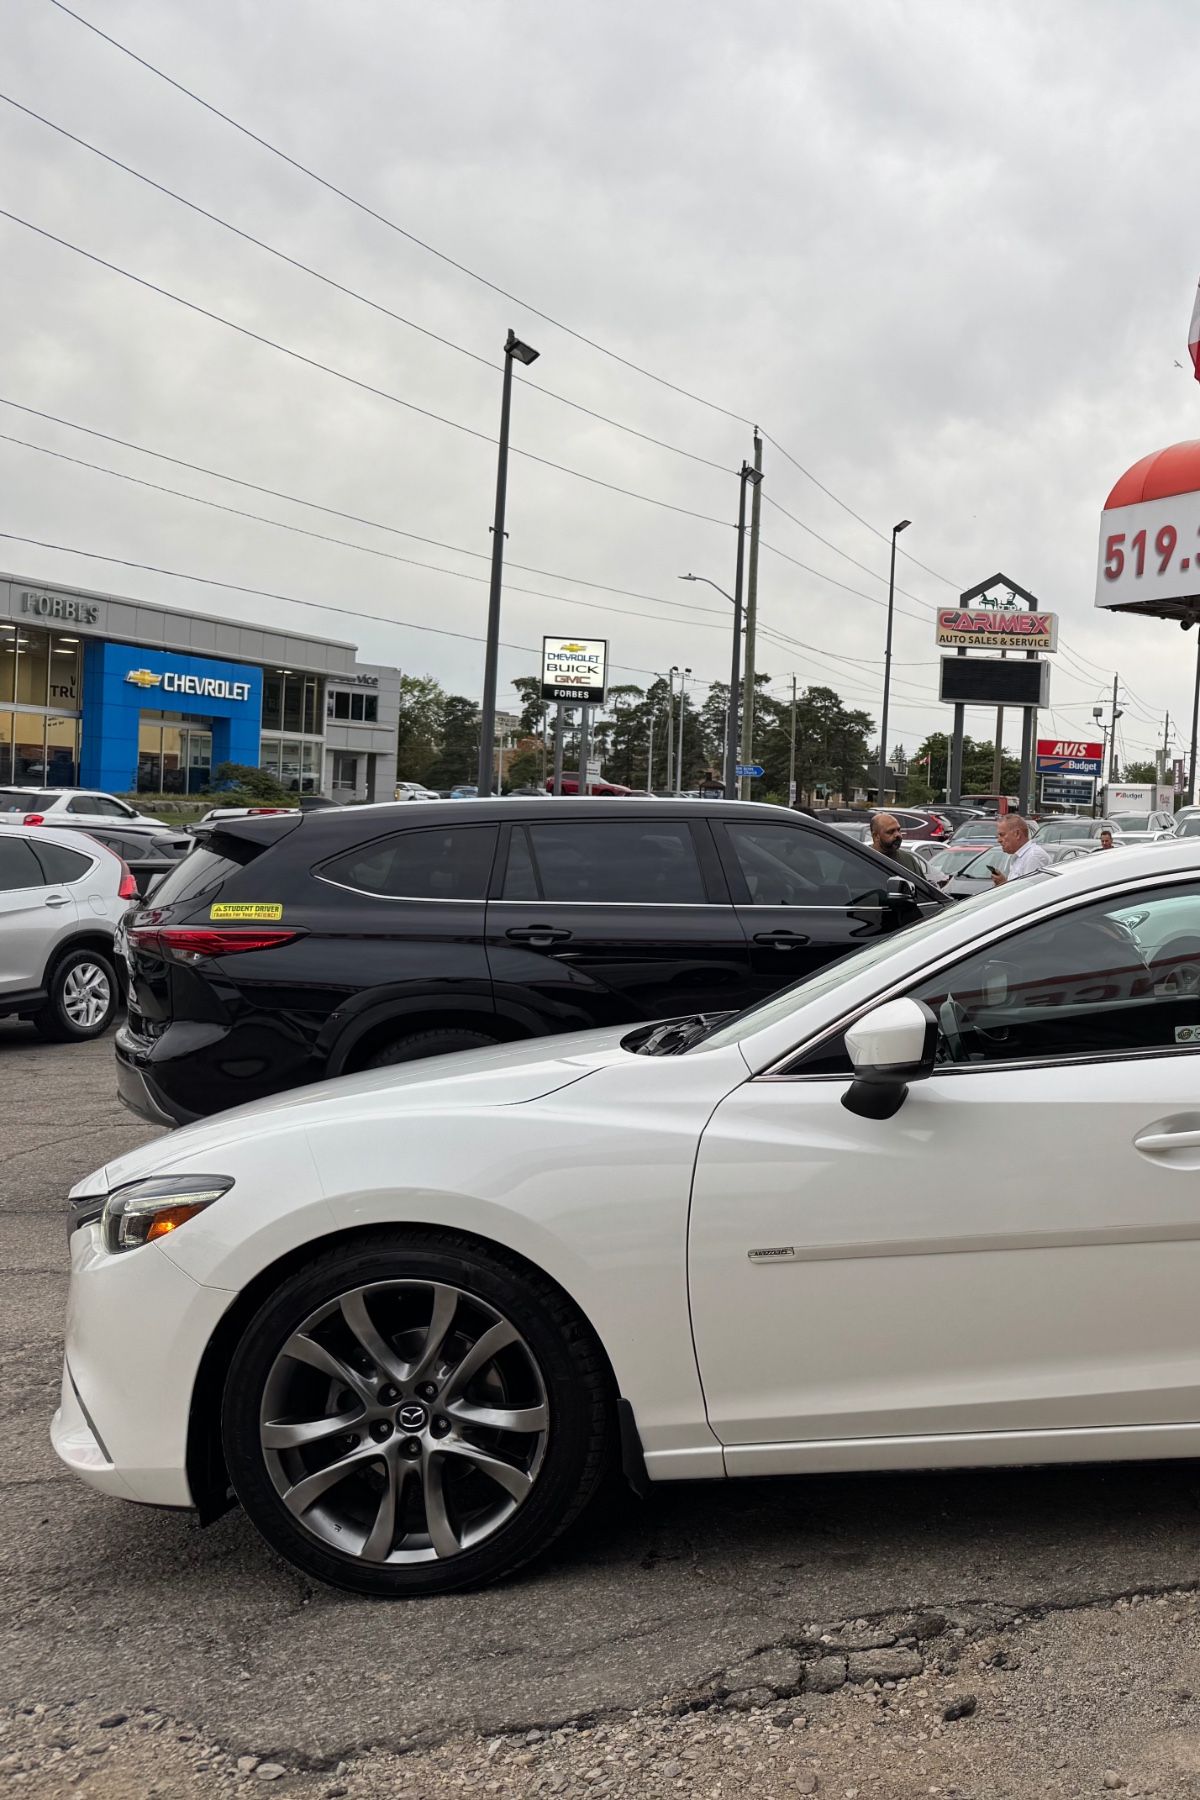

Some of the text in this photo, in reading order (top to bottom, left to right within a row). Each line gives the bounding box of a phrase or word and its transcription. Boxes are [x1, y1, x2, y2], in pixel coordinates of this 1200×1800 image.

[22, 592, 100, 624] FORBES
[940, 611, 1050, 635] CARIMEX
[939, 635, 1050, 648] AUTO SALES & SERVICE
[548, 653, 600, 663] CHEVROLET
[547, 664, 599, 675] BUICK
[555, 675, 591, 685] GMC
[164, 672, 252, 702] CHEVROLET
[554, 690, 589, 699] FORBES
[1052, 742, 1088, 757] AVIS
[1068, 760, 1098, 772] Budget
[1122, 792, 1143, 800] Budget
